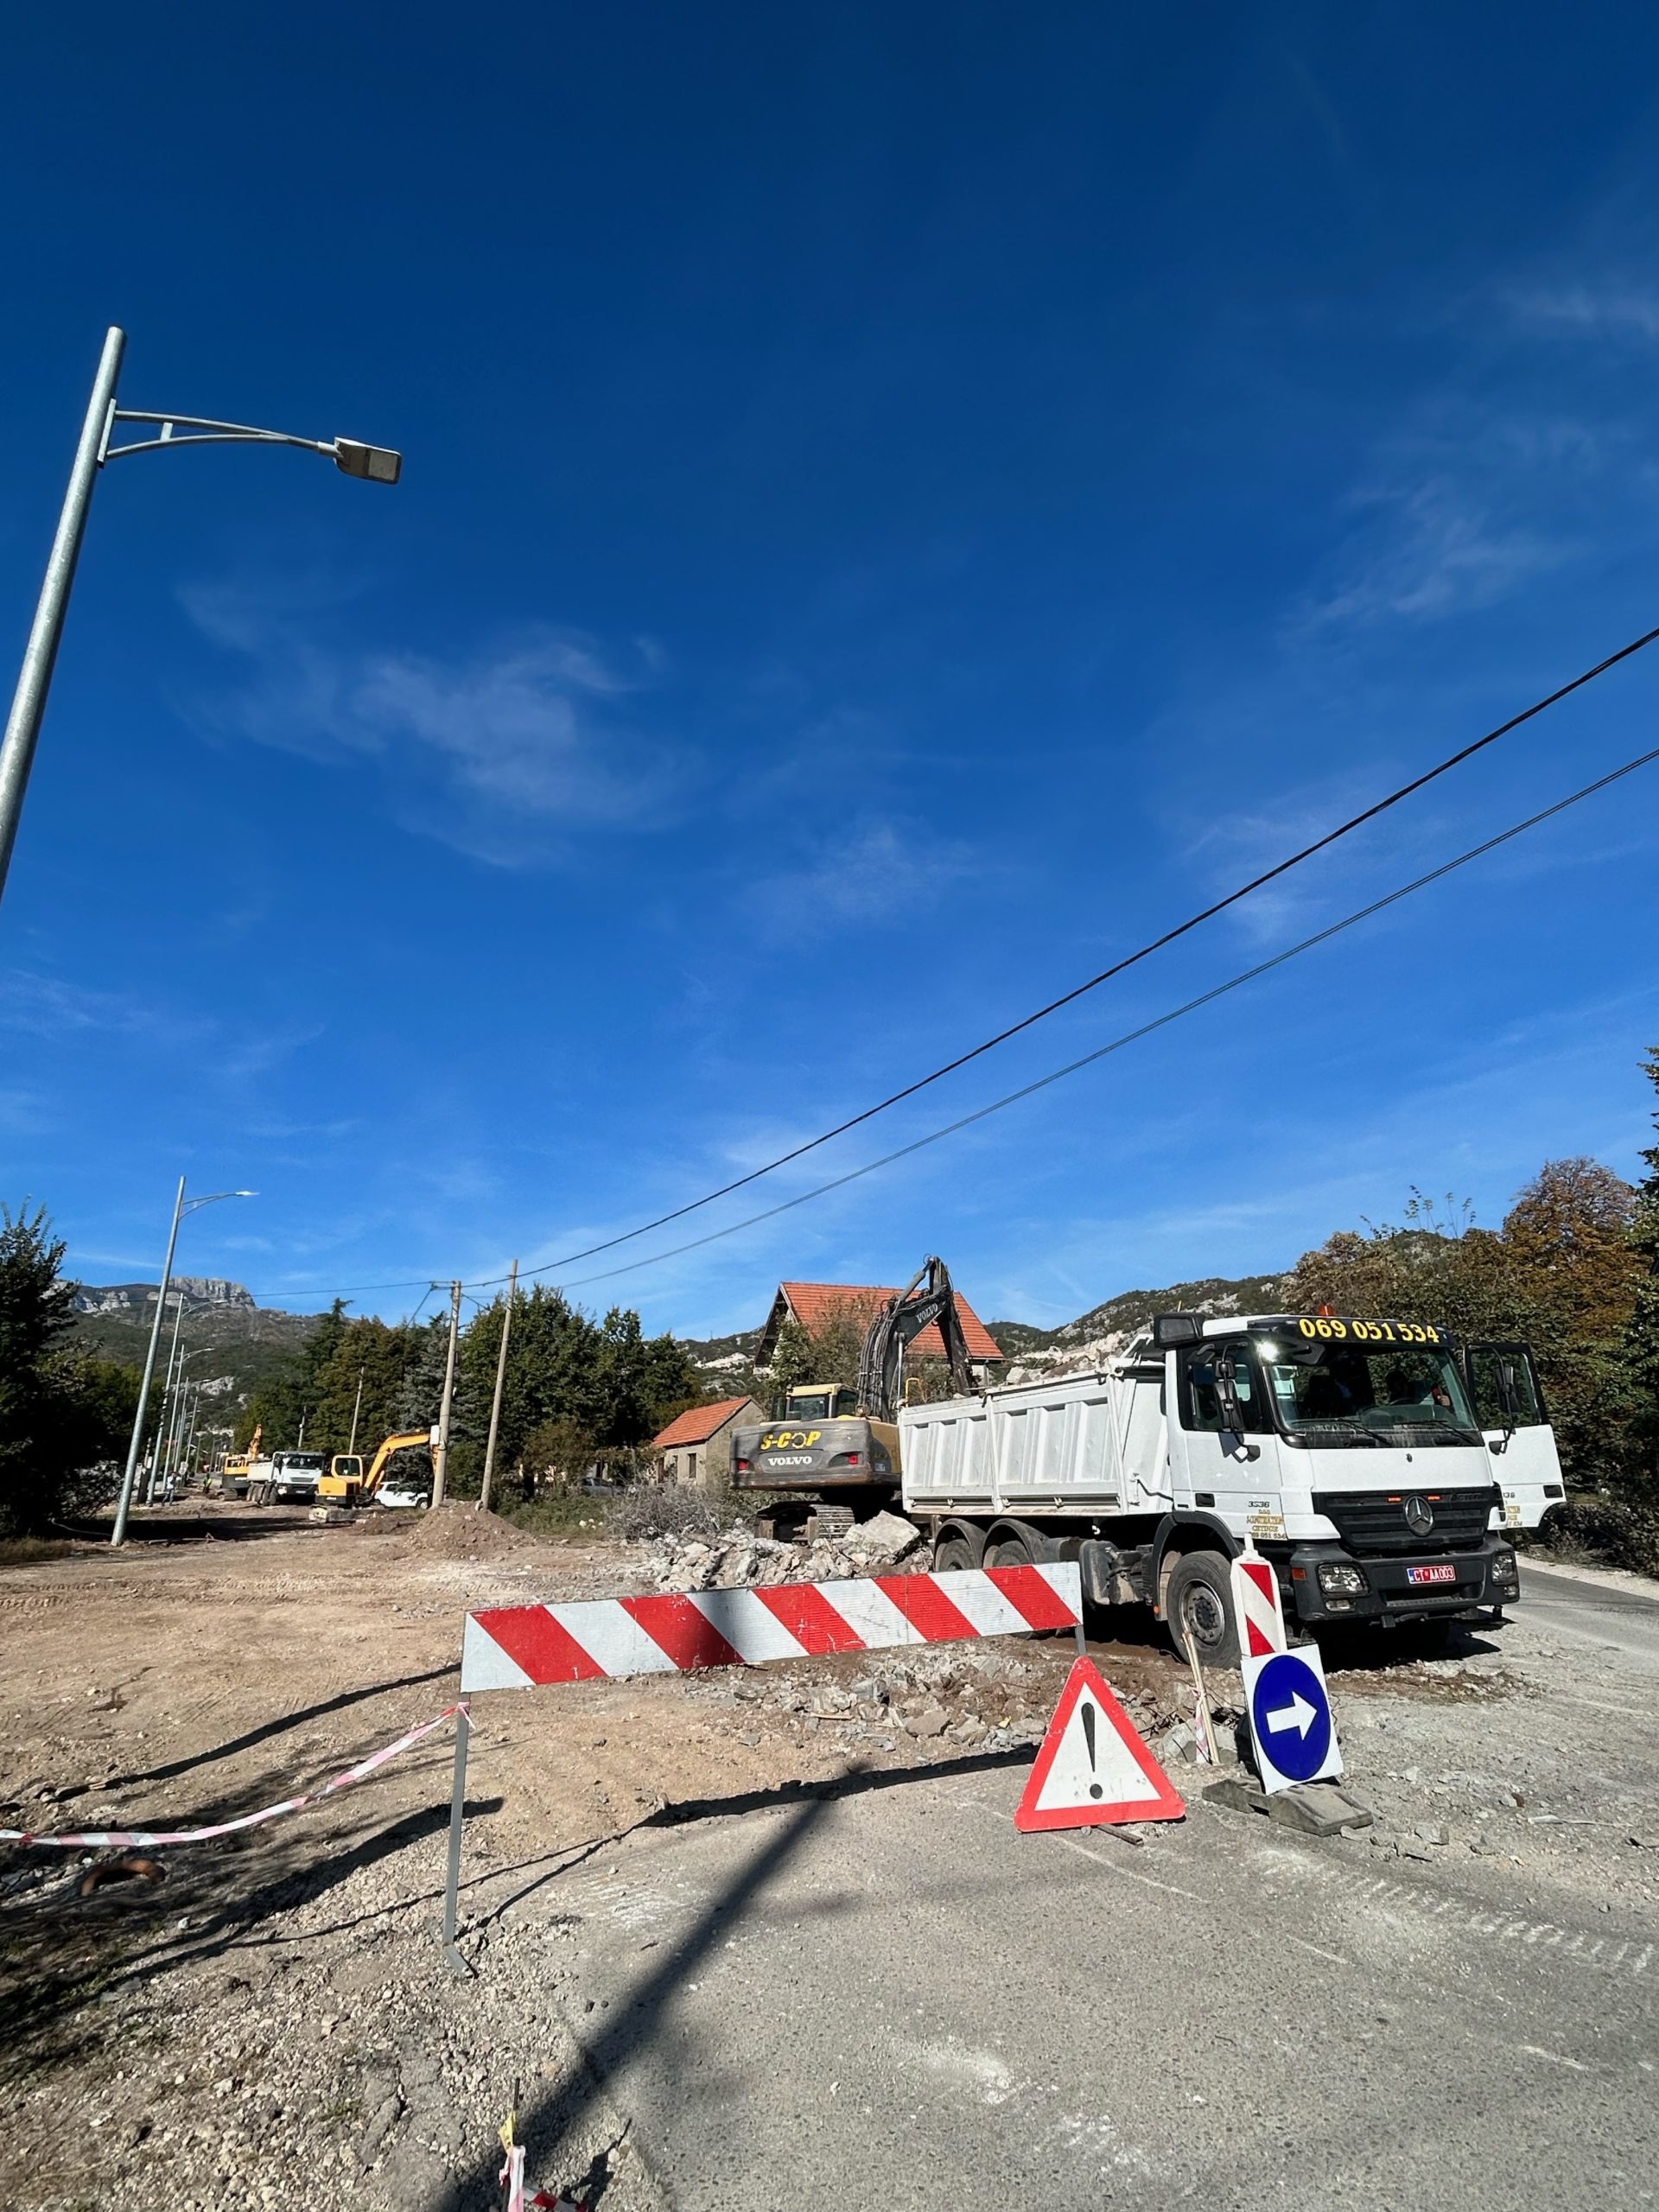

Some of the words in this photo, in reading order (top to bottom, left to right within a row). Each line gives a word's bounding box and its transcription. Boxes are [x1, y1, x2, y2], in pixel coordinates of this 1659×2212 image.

[916, 1303, 938, 1323] VOLVO
[1299, 1318, 1347, 1338] 069
[1351, 1320, 1396, 1340] 051
[1396, 1323, 1440, 1344] 534
[767, 1455, 813, 1466] VOLVO
[1414, 1569, 1425, 1581] CT
